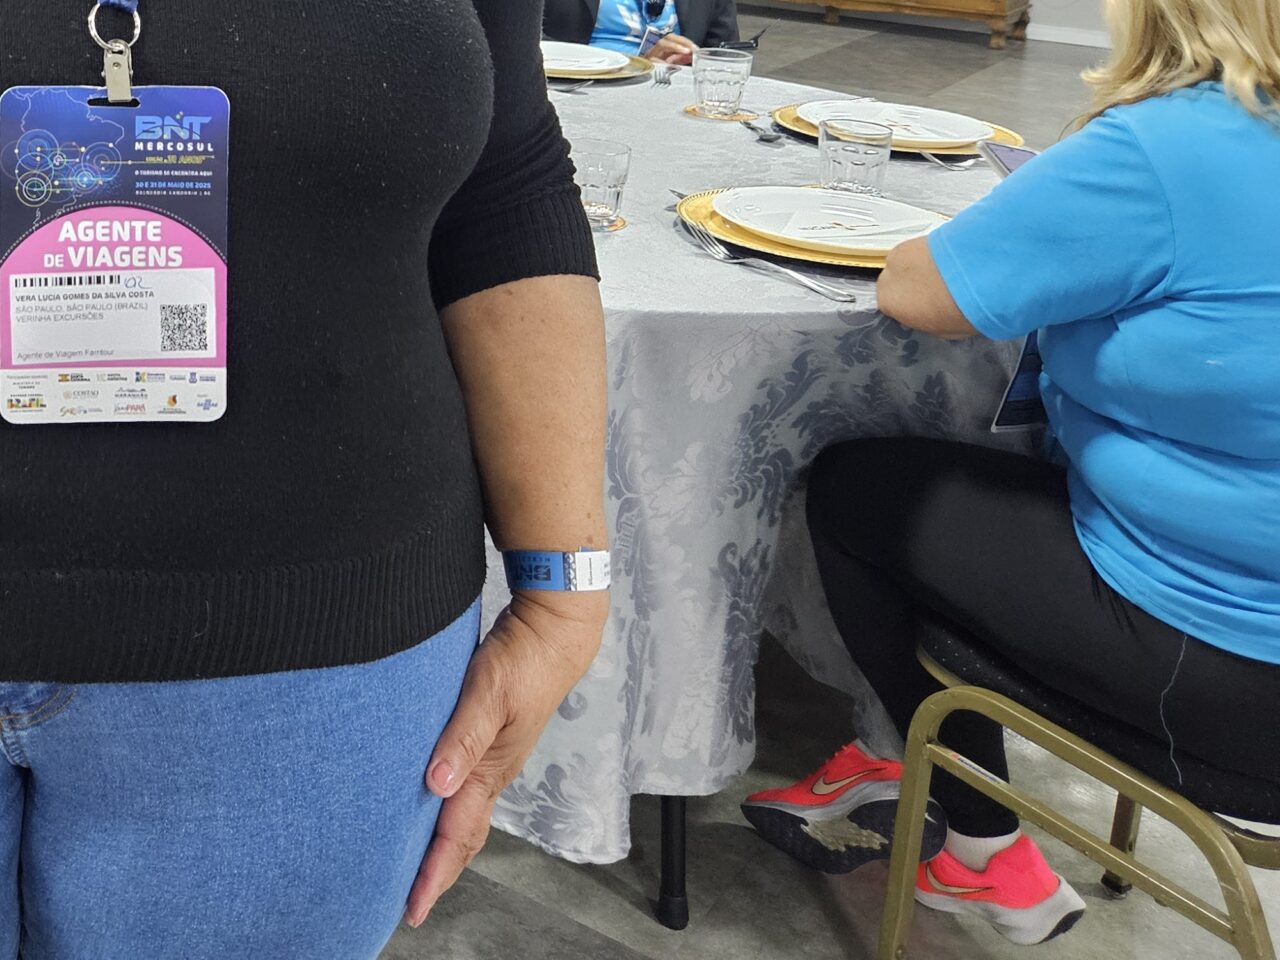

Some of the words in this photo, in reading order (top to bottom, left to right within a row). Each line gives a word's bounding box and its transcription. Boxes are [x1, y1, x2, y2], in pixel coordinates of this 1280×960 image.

[135, 115, 212, 140] BNT
[135, 142, 214, 151] MERCOSUL
[58, 220, 162, 242] AGENTE
[44, 253, 65, 267] DE
[67, 245, 183, 268] VIAGENS
[16, 294, 36, 302] VERA
[16, 305, 32, 313] SÃO
[66, 303, 84, 311] SÃO
[85, 303, 113, 311] PAULO
[114, 302, 148, 311] (BRAZIL)
[16, 314, 51, 323] VERINHA
[53, 312, 104, 322] EXCURSÕES
[17, 352, 43, 361] Agente
[44, 351, 54, 359] de
[55, 350, 83, 359] Viagem
